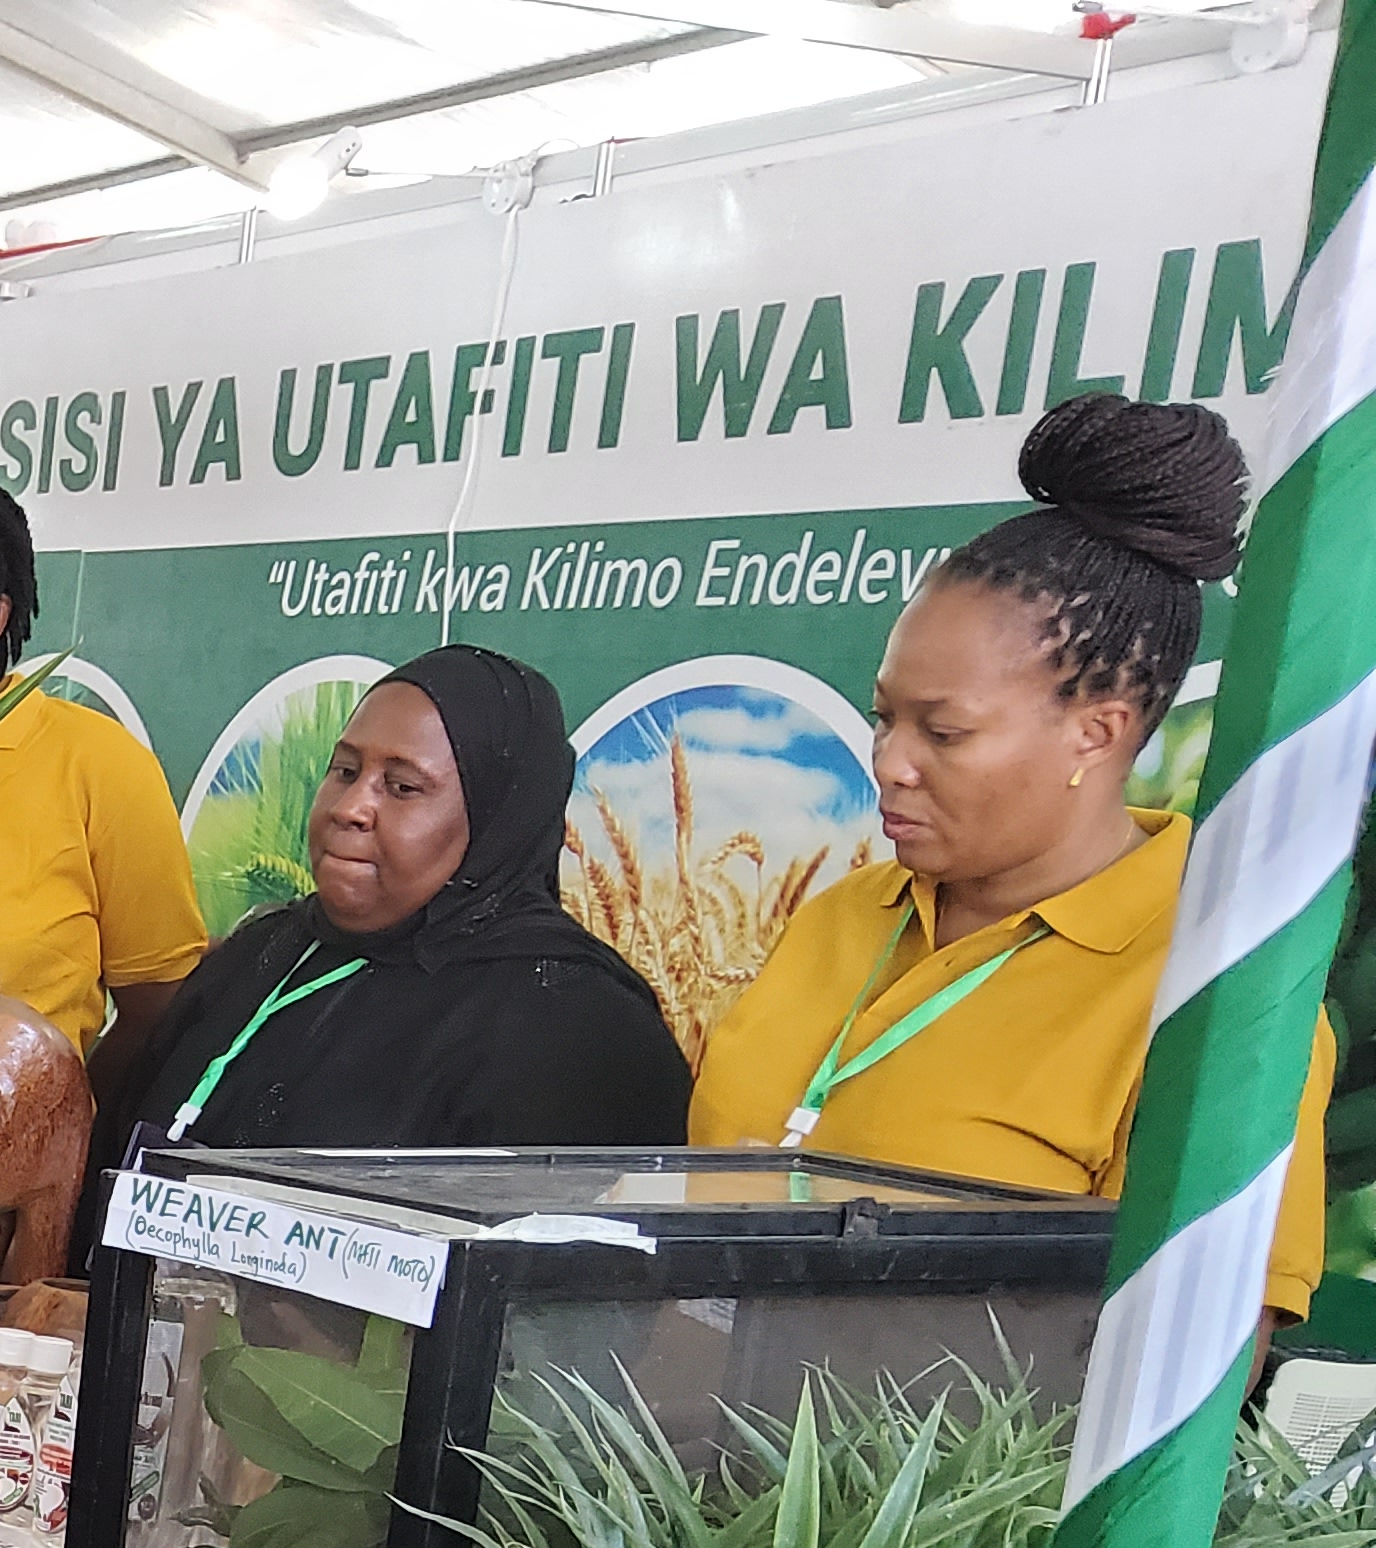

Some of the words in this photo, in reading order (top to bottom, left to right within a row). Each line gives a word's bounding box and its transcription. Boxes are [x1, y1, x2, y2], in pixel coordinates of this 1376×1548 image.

[151, 376, 242, 488] YA
[273, 323, 636, 477] UTAFITI
[675, 295, 852, 443] WA
[415, 549, 510, 614] kwa
[528, 539, 681, 611] Kilimo
[132, 1178, 270, 1239] WEAVER
[284, 1220, 346, 1260] ANT
[387, 1255, 435, 1292] MOTO)
